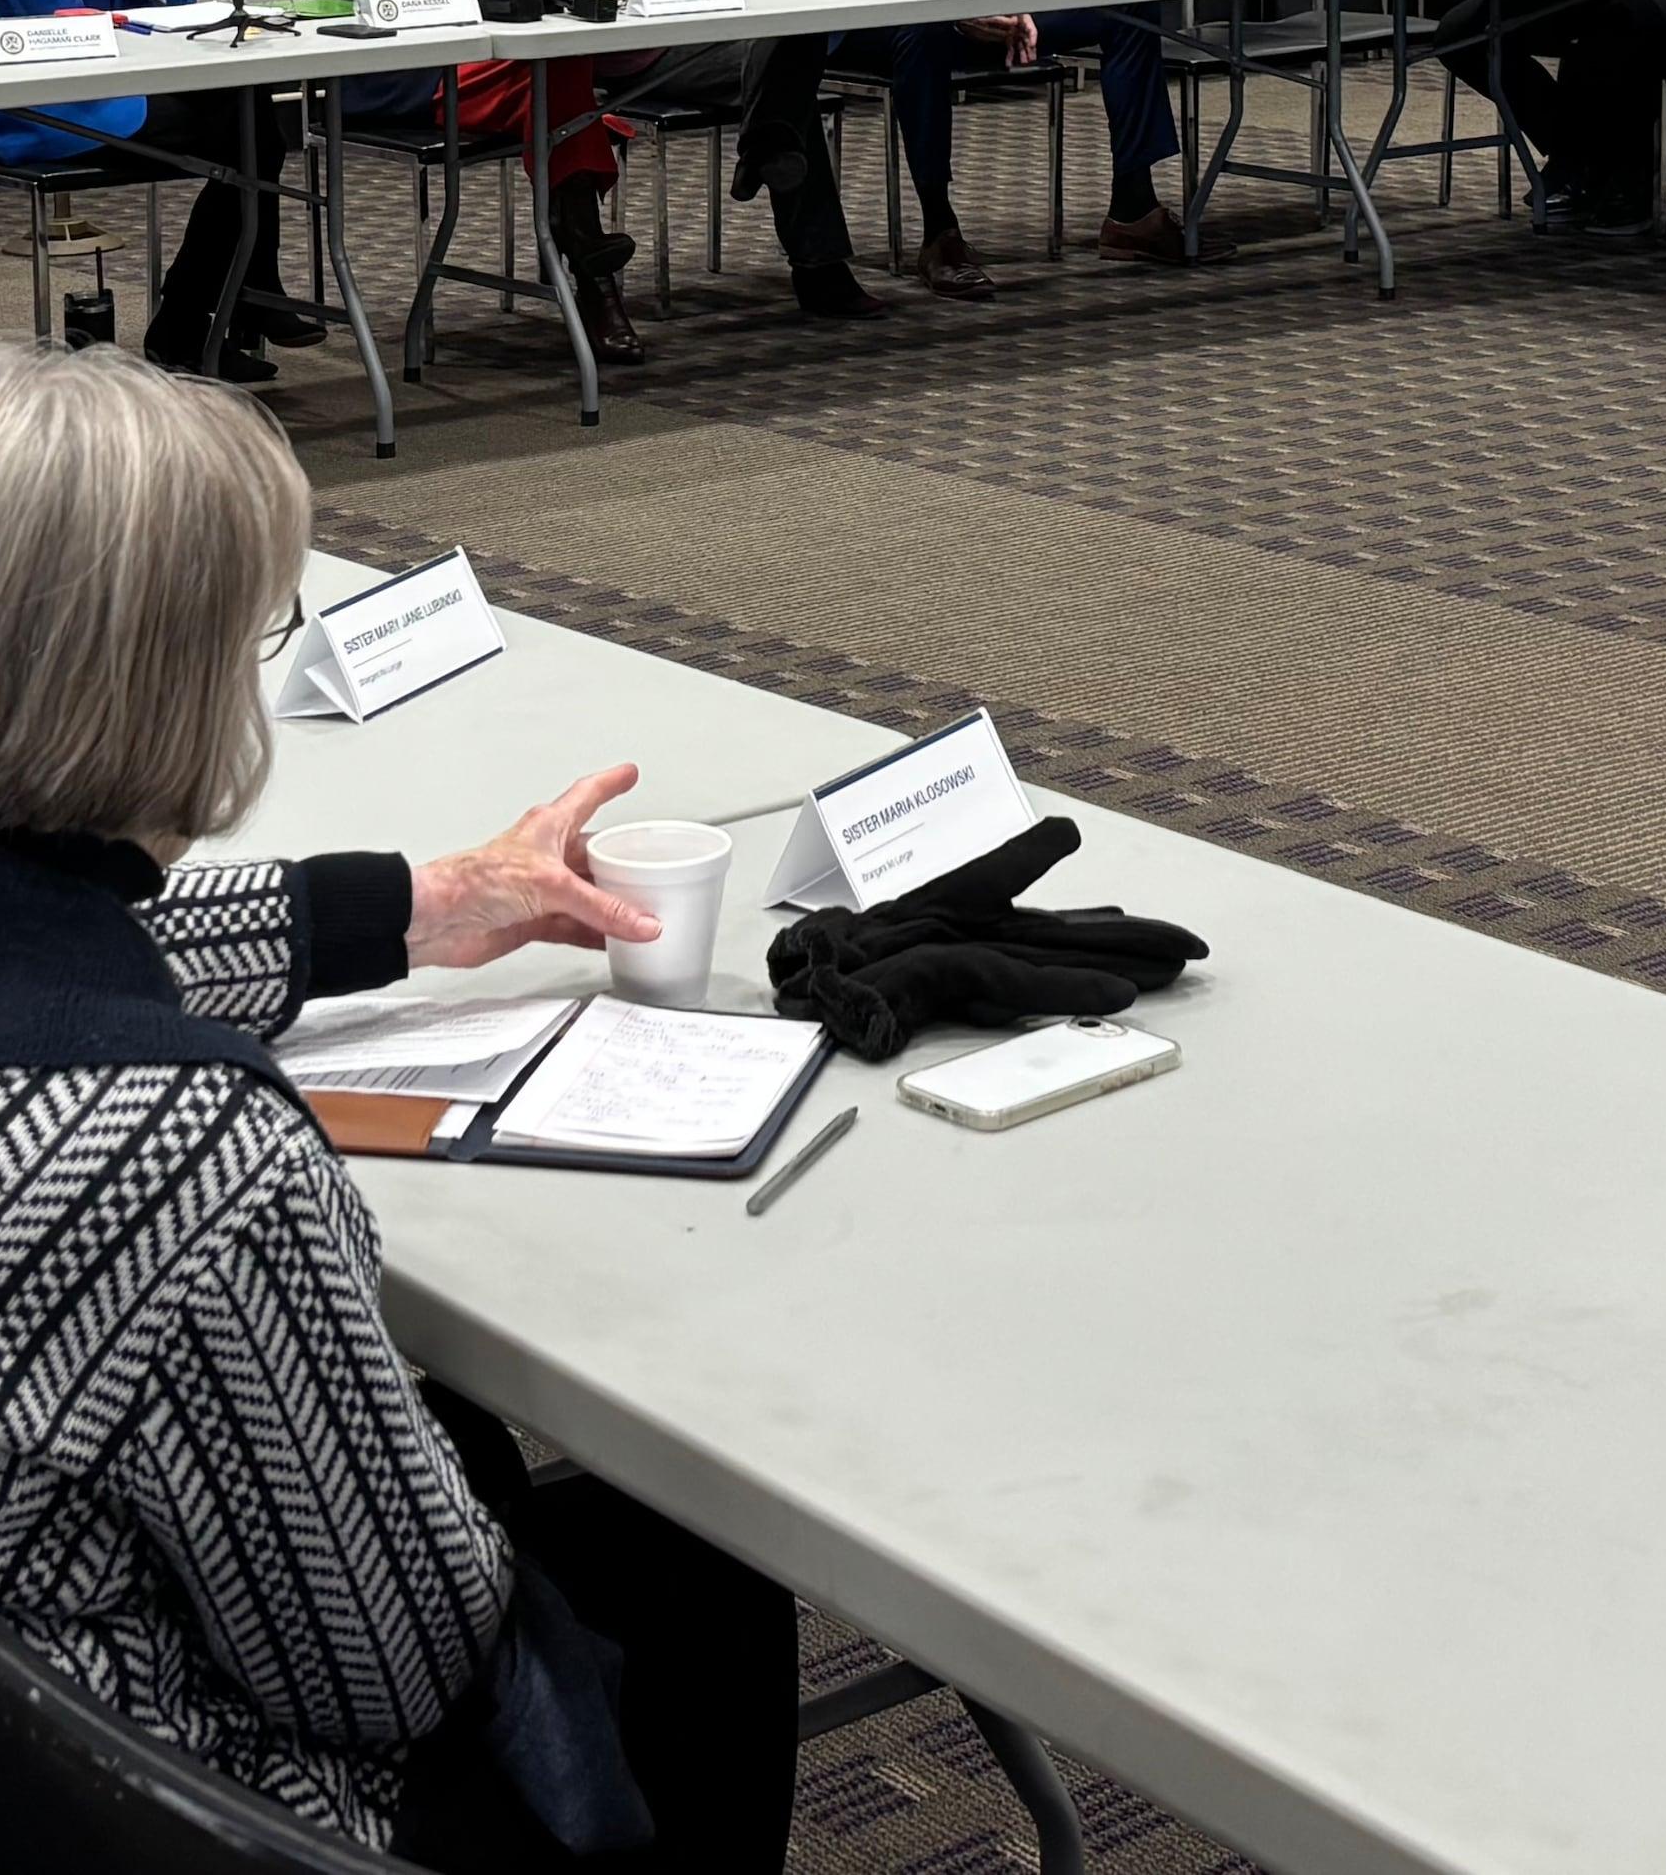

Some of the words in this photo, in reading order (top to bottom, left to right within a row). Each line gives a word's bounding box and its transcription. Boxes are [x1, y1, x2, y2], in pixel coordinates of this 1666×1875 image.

[343, 630, 376, 655] SISTER
[374, 618, 399, 640] MARY
[401, 606, 425, 628] JANE
[842, 813, 882, 845] SISTER
[879, 796, 916, 826] MARIA
[913, 764, 976, 808] KLOSOWSKI
